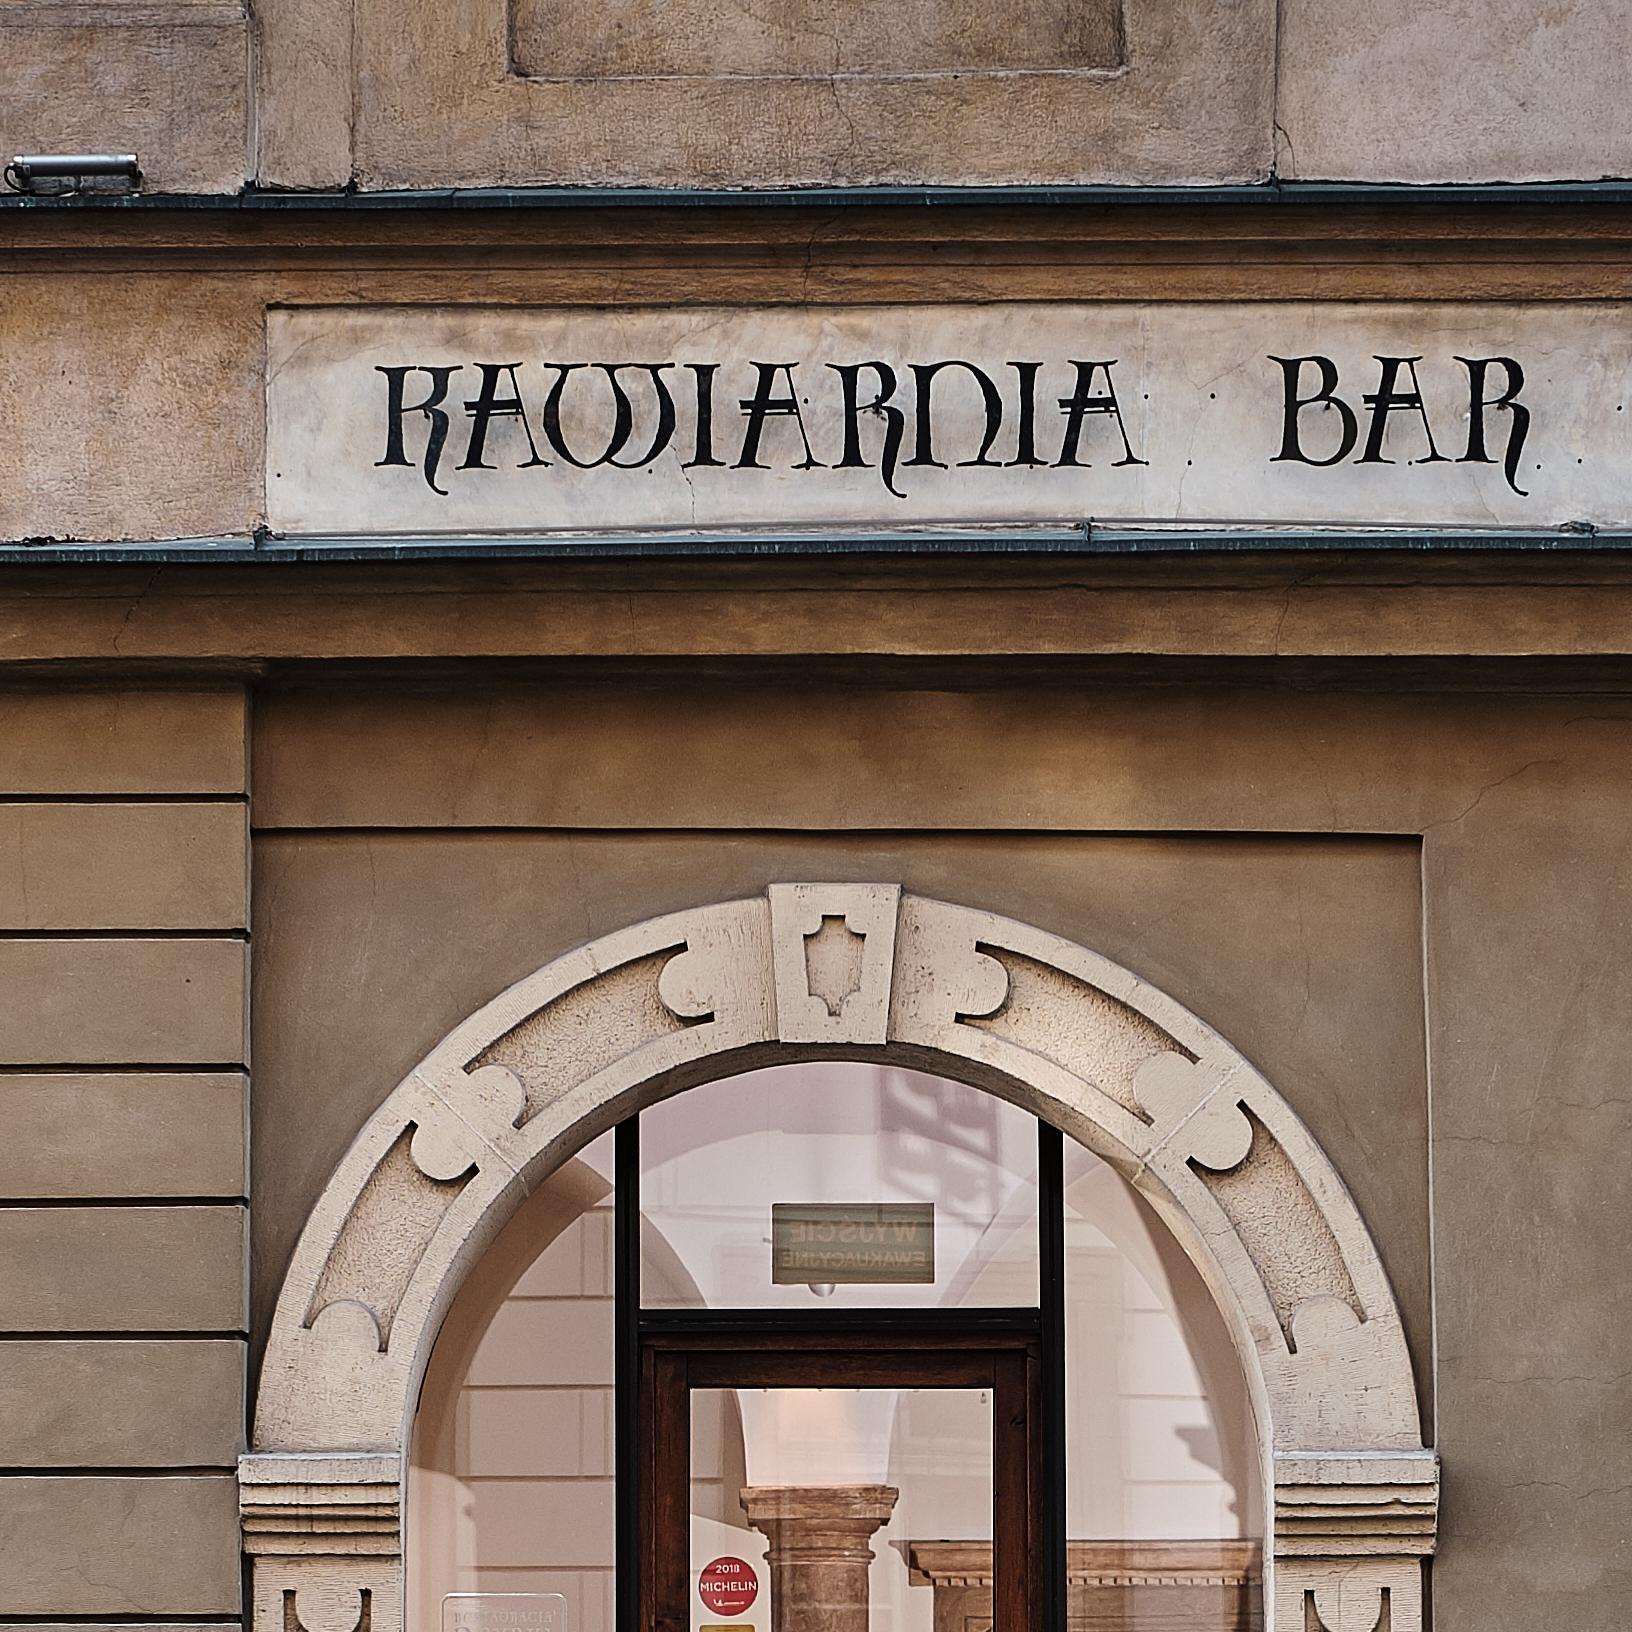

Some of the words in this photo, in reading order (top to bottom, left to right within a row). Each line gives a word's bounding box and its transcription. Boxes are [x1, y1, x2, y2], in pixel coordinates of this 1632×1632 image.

[373, 358, 1150, 498] KAWIARNIA
[1266, 352, 1532, 499] BAR
[700, 1581, 757, 1592] MICHELIN
